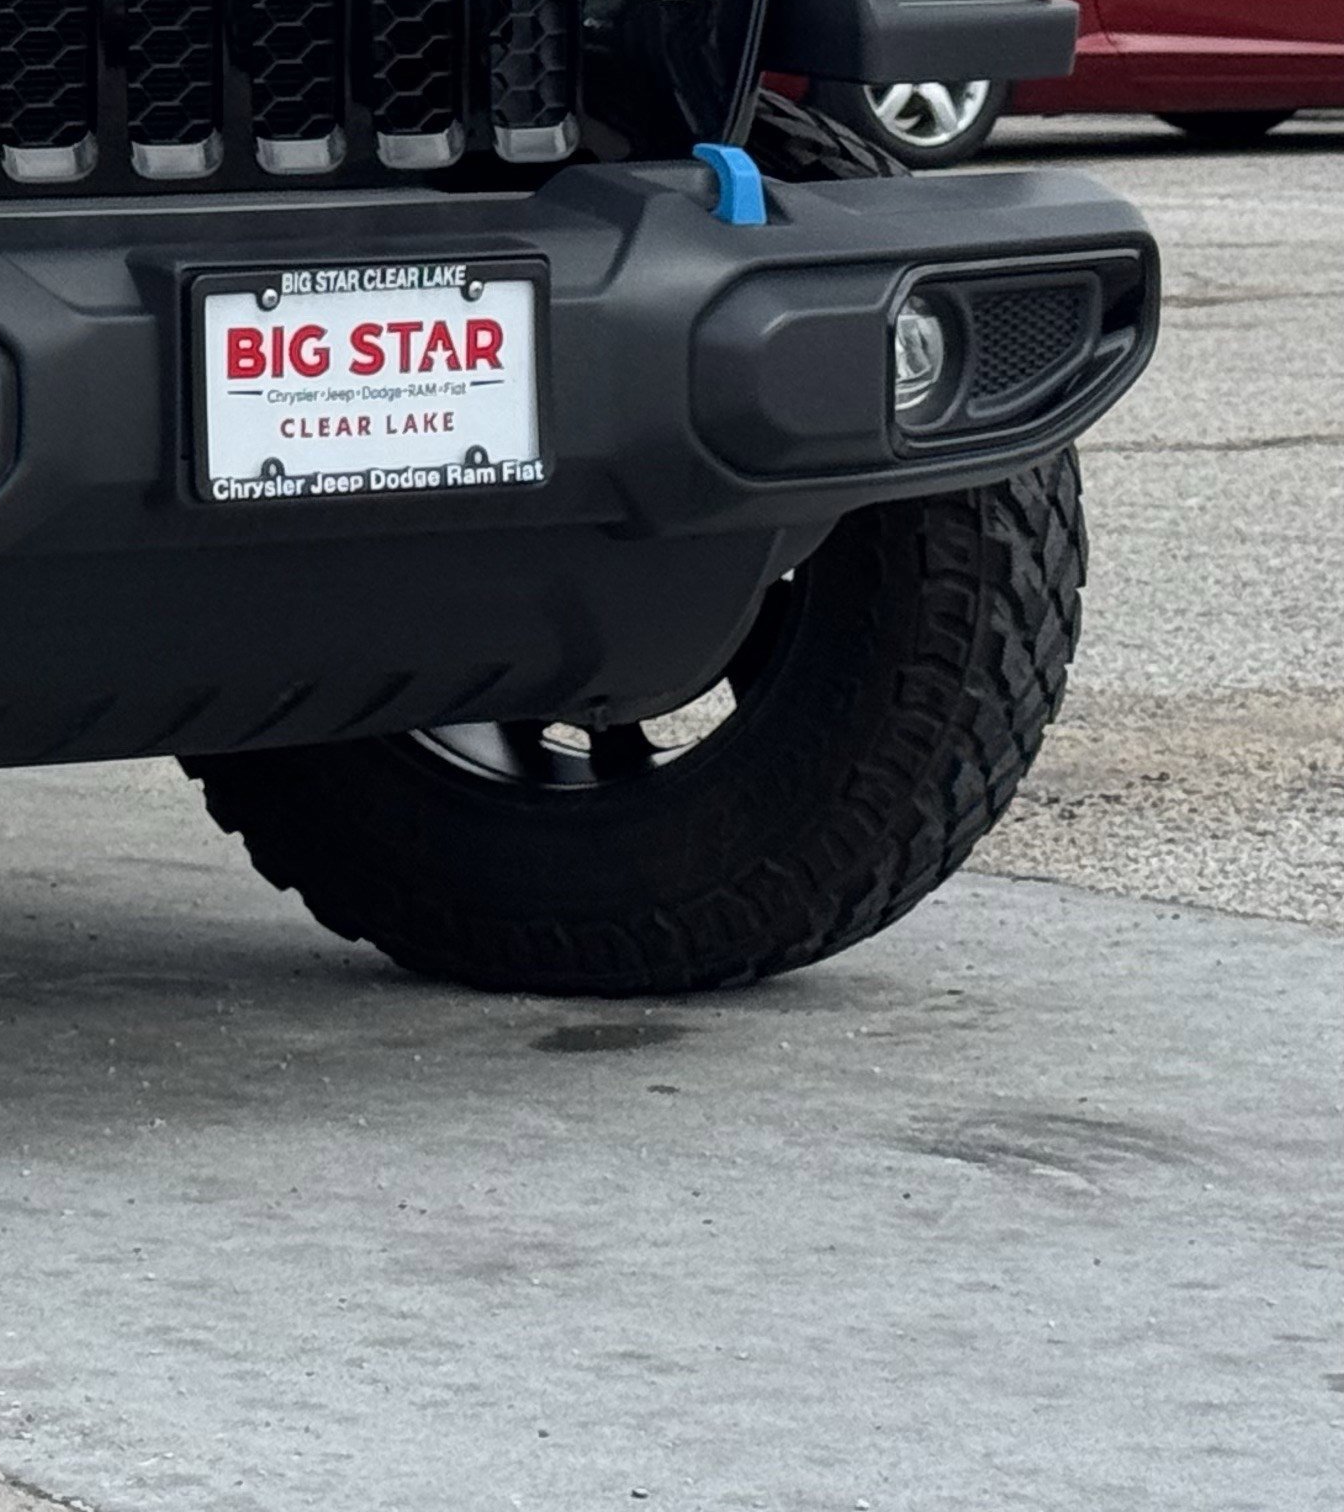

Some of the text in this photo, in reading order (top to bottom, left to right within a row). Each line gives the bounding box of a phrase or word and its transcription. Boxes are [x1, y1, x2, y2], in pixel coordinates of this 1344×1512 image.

[281, 265, 467, 294] BIG STAR CLEAR LAKE
[226, 318, 505, 380] BIG STAR
[280, 412, 455, 439] CLEAR LAKE
[212, 459, 544, 501] Chrysler Jeep Dodge Ram Fiat
